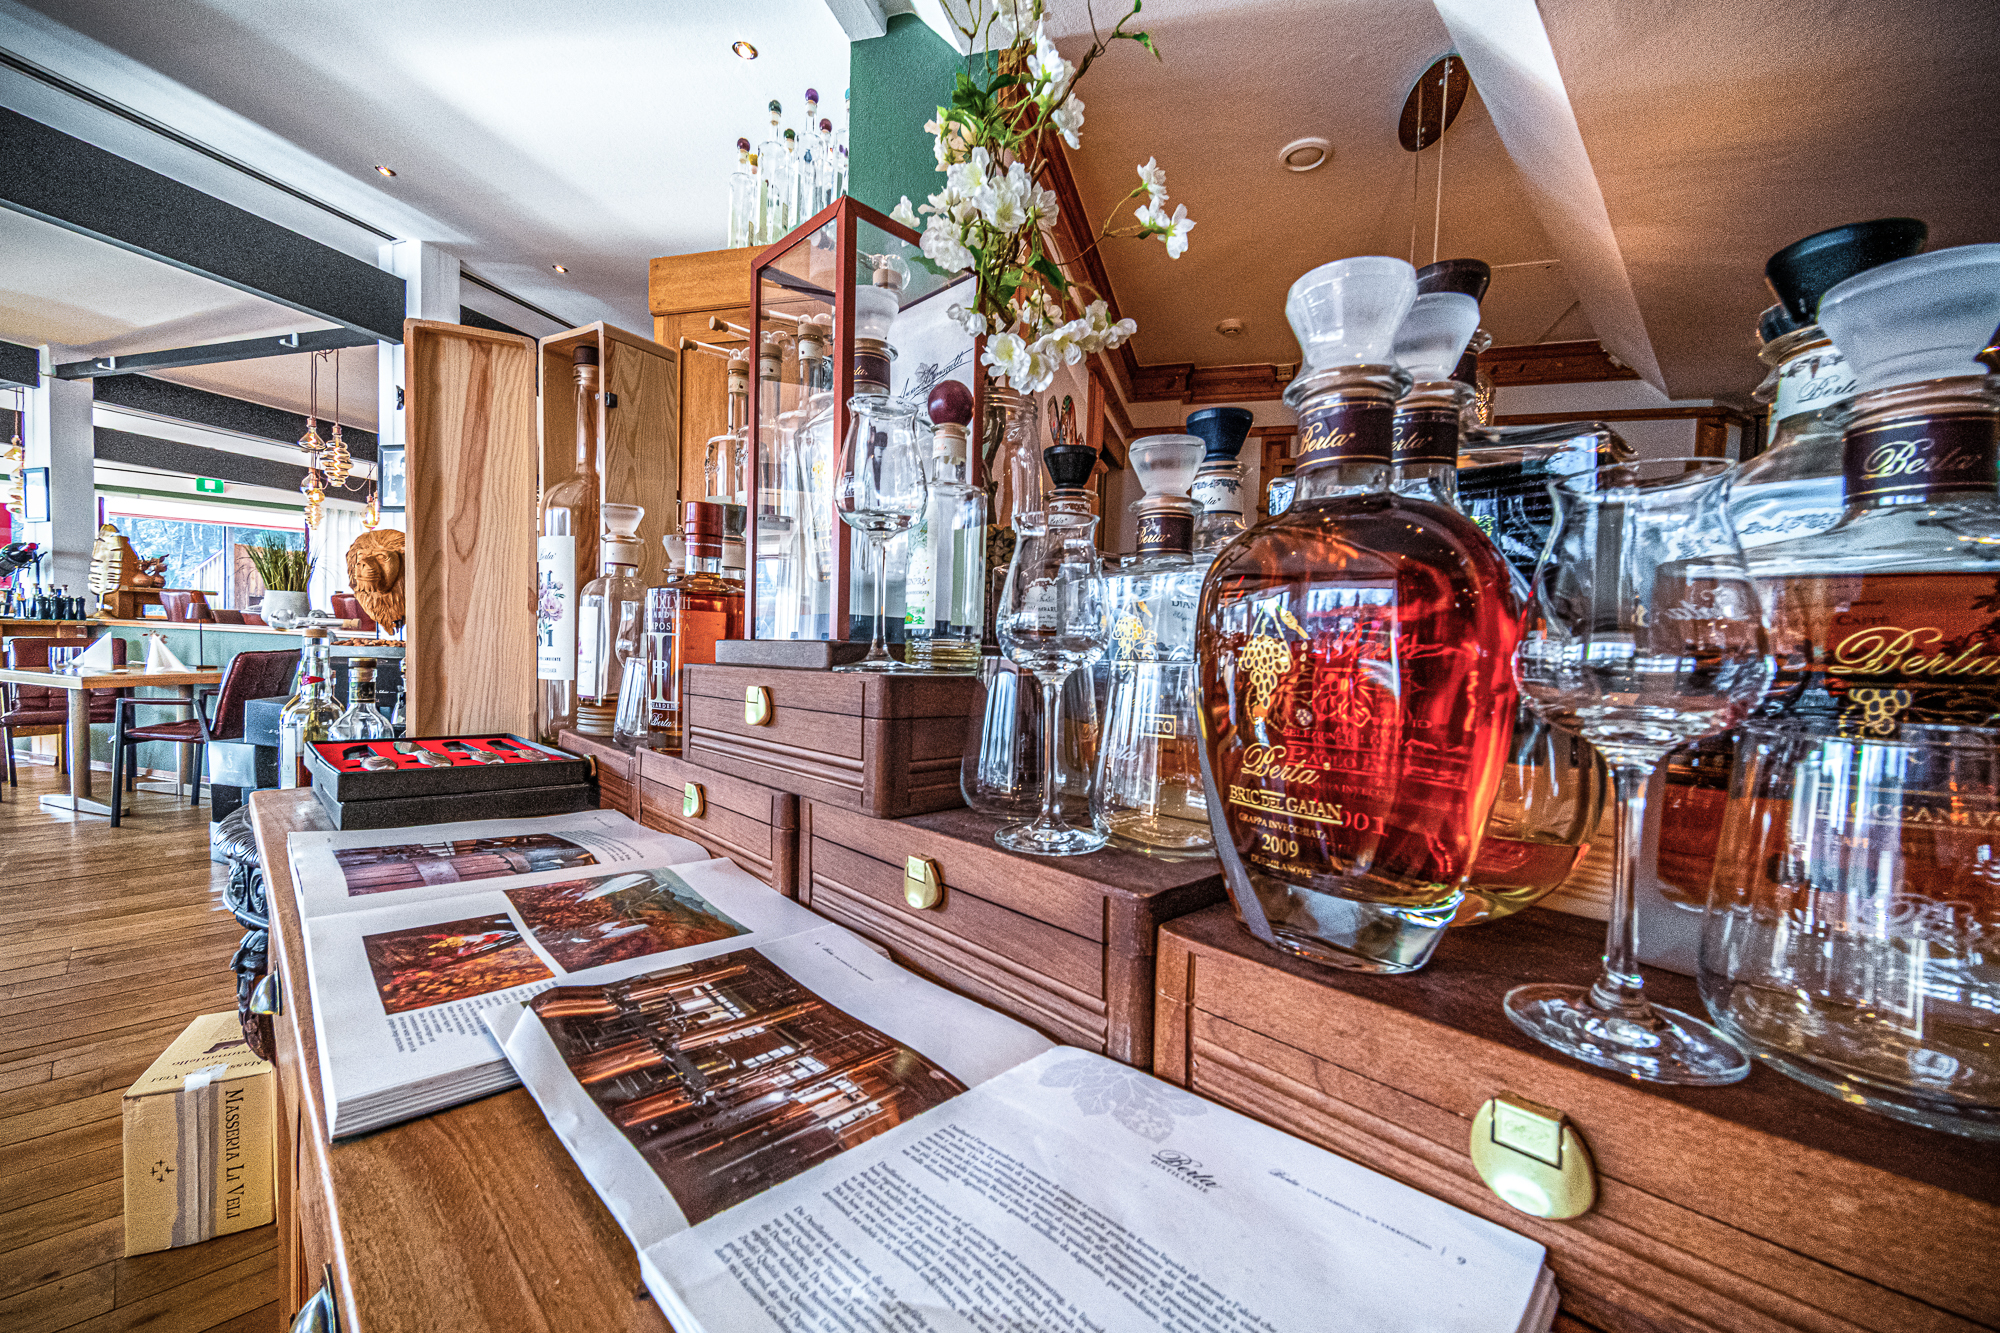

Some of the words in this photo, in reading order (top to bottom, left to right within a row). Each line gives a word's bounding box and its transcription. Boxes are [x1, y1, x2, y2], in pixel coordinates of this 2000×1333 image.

[1392, 427, 1434, 452] erta
[1860, 437, 1982, 481] Berta
[1240, 742, 1320, 785] Berta
[1229, 784, 1260, 805] BRIC
[1260, 795, 1286, 810] DEL
[1286, 797, 1343, 820] GAIAN
[1238, 811, 1268, 828] GRAPPA
[1261, 833, 1300, 858] 2009
[1250, 853, 1313, 879] DUEMILANOVE
[225, 1088, 245, 1162] MASSERIA
[226, 1163, 245, 1183] LI
[1151, 1149, 1222, 1189] Berta
[226, 1183, 245, 1220] VELI
